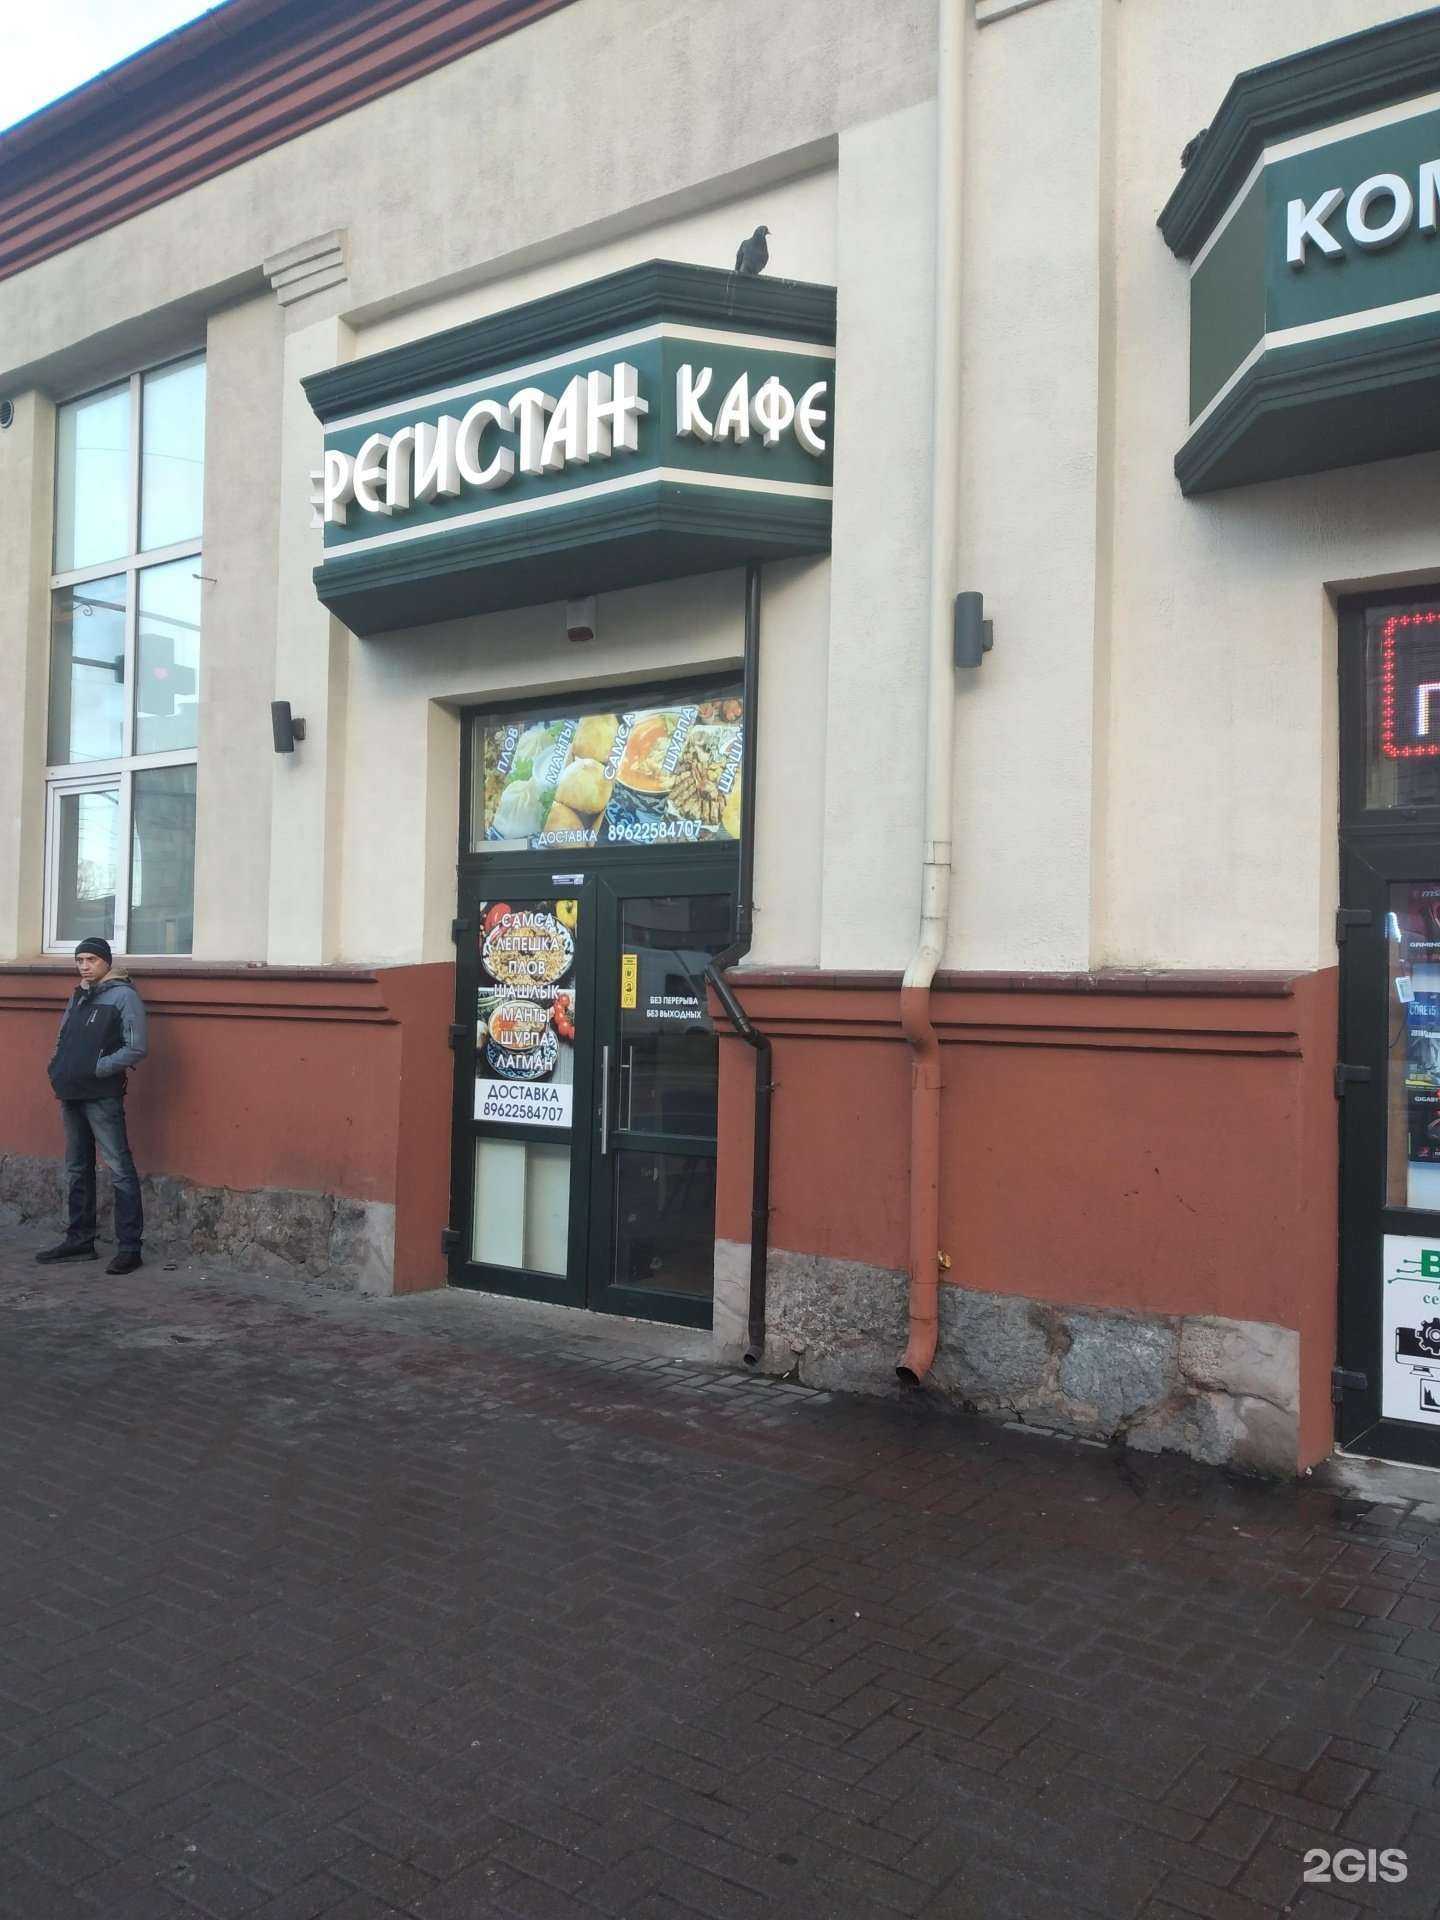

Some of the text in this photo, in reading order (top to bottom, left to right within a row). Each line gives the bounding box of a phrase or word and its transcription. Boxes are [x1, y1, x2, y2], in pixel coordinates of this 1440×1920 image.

[676, 363, 828, 457] КАФЕ
[324, 362, 649, 526] РЕГИСТАН
[603, 713, 635, 780] САМСА
[662, 706, 696, 772] ШУРПА
[496, 727, 518, 774] ПЛОВ
[538, 820, 701, 845] ДОСТАВКА 89622584707
[501, 912, 555, 928] САМСА
[496, 936, 560, 951] ЛЕПЕШКА
[508, 960, 545, 975] ПЛОВ
[494, 984, 559, 999] ШАШЛЫК
[650, 996, 698, 1005] БЕЗ ПЕРЕРЫВА
[502, 1007, 550, 1022] МАНТЫ
[646, 1009, 702, 1020] БЕЗ ВЫХОДНЫХ
[500, 1031, 548, 1046] ШУРПА
[495, 1054, 553, 1071] ЛАГМАН
[487, 1085, 559, 1102] ДОСТАВКА
[483, 1102, 563, 1121] 89622584707
